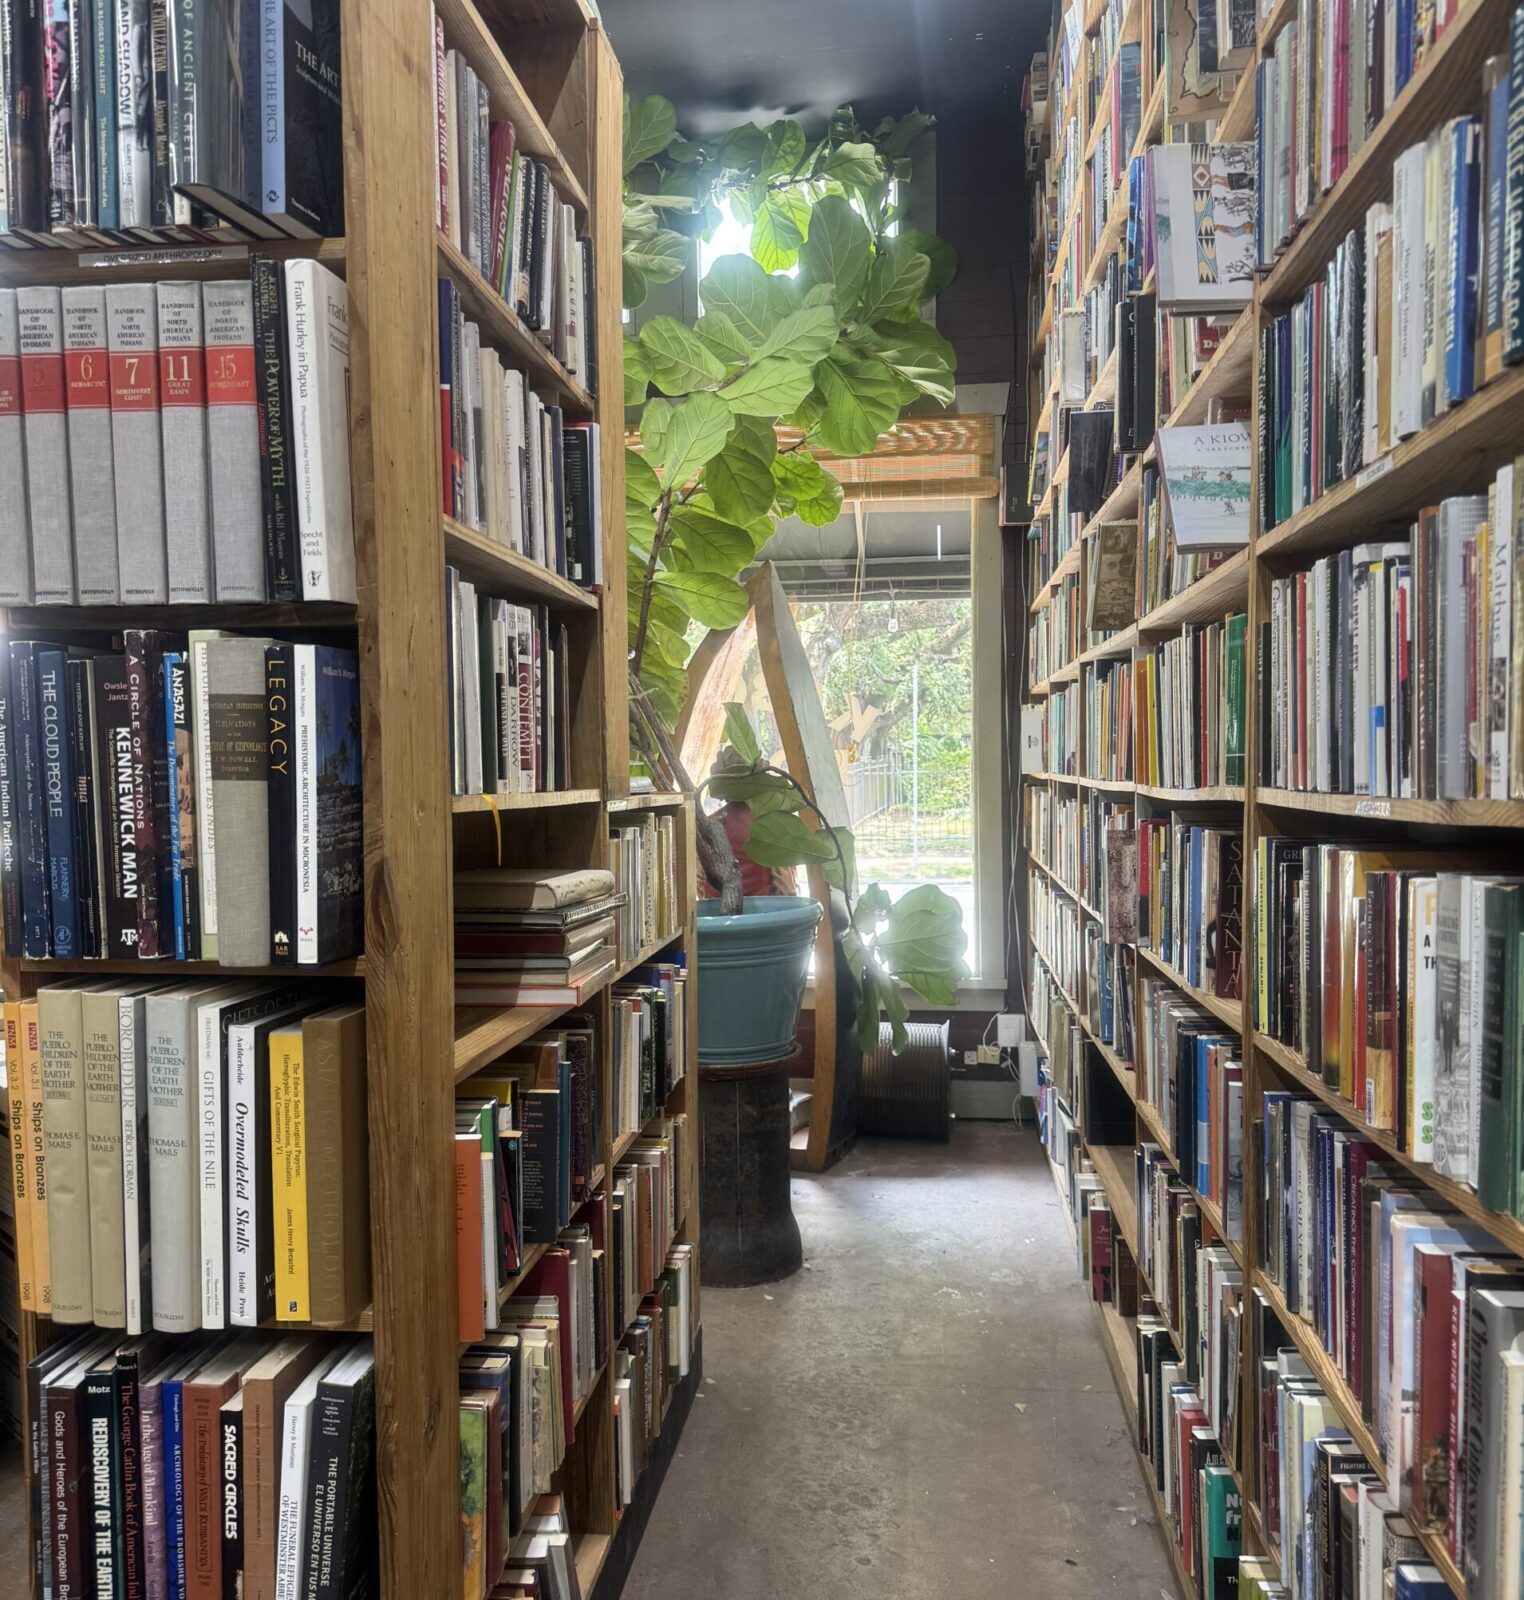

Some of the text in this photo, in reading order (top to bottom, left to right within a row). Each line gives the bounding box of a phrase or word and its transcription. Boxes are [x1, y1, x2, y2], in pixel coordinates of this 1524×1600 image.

[118, 0, 131, 115] AND SHADOW
[153, 9, 168, 72] CIVILIZATION
[295, 40, 318, 72] THE
[184, 0, 194, 164] OF ANCIENT CRETE
[265, 18, 278, 144] ART OF THE PICTS
[153, 250, 222, 261] ANTHROPOLOGY
[81, 354, 93, 380] 6
[166, 356, 192, 381] 11
[294, 281, 310, 398] Frank Hurley in Papua
[125, 358, 139, 385] 7
[265, 330, 285, 486] THE POWER OF MYTH
[1195, 432, 1252, 445] A KIOW
[276, 513, 285, 529] Bill
[1495, 544, 1506, 642] Malthus
[173, 668, 184, 724] ANASAZI
[269, 660, 287, 774] LEGACY
[520, 672, 532, 760] CONTEMPT
[42, 671, 62, 817] THE CLOUD PEOPLE
[130, 656, 144, 829] A CIRCLE OF NATIONS
[1, 779, 10, 816] Indian
[116, 728, 138, 898] KENNEWICK MAN
[302, 836, 309, 844] IN
[60, 857, 70, 898] FLANNERY
[1224, 841, 1242, 991] SATANTA
[1424, 934, 1431, 948] A
[48, 1031, 64, 1039] THE
[120, 1005, 134, 1108] BOROBUDUR
[150, 1046, 179, 1055] PUEBLO
[158, 1036, 173, 1045] THE
[88, 1063, 97, 1071] OF
[88, 1073, 113, 1081] EARTH
[152, 1066, 179, 1075] OF THE
[152, 1076, 178, 1085] EARTH
[10, 1100, 25, 1199] Ships on Bronzes
[31, 1102, 46, 1200] Ships on Bronzes
[48, 1140, 72, 1149] MAILS
[92, 1144, 115, 1152] MAILS
[155, 1148, 177, 1156] MAILS
[204, 1071, 216, 1189] GIFTS OF THE NILE
[235, 1102, 249, 1200] Overmodeled
[236, 1207, 250, 1253] Skulls
[88, 1385, 110, 1394] Motz
[55, 1410, 69, 1580] Gods and Heroes of the European
[92, 1417, 112, 1554] REDISCOVERY OF THE
[120, 1382, 138, 1579] The George Catlin Book of American
[140, 1410, 158, 1526] In the Age of Mankind
[174, 1444, 182, 1501] ARCHEOLOGY
[225, 1424, 238, 1539] SACRED CIRCLES
[176, 1504, 183, 1516] OF
[278, 1495, 289, 1575] OF WESTMINSTER
[288, 1500, 298, 1563] THE FUNERAL
[308, 1484, 324, 1590] EL UNIVERSO EN TUS
[320, 1457, 338, 1586] THE PORTABLE UNIVERSE
